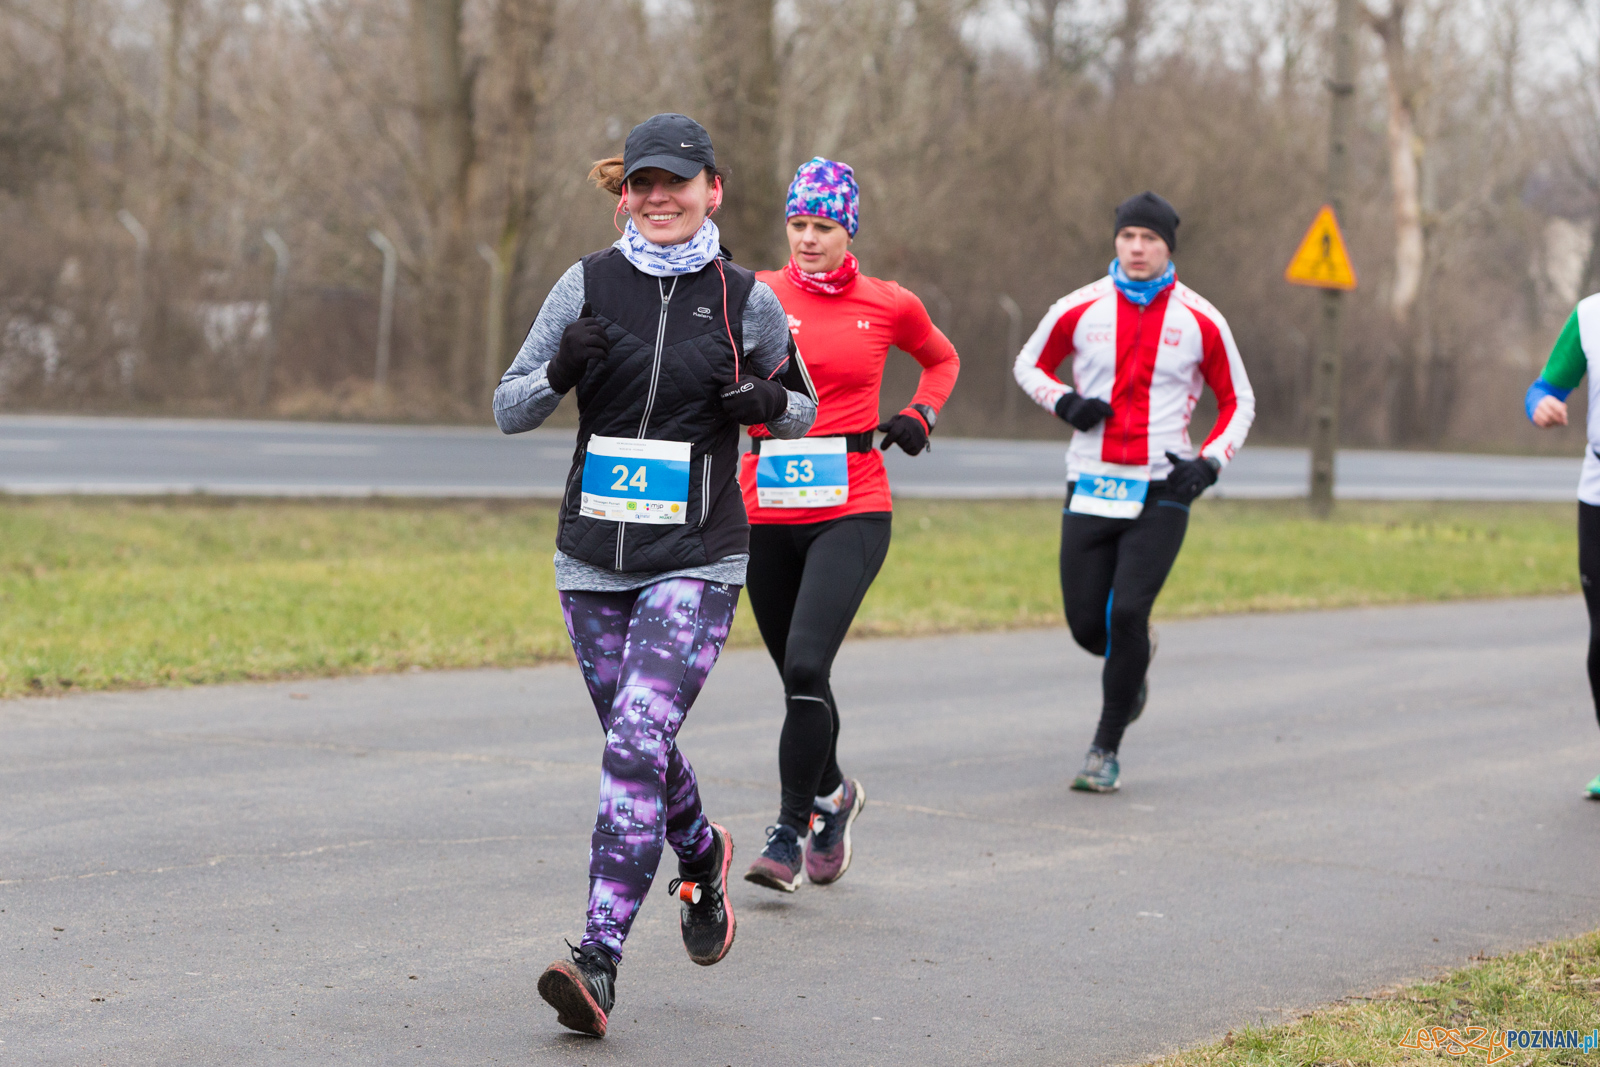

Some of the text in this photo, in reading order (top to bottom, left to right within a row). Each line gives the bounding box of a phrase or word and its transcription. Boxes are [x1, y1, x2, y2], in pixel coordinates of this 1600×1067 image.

[611, 465, 648, 492] 24
[784, 459, 815, 483] 53
[1093, 477, 1129, 500] 226
